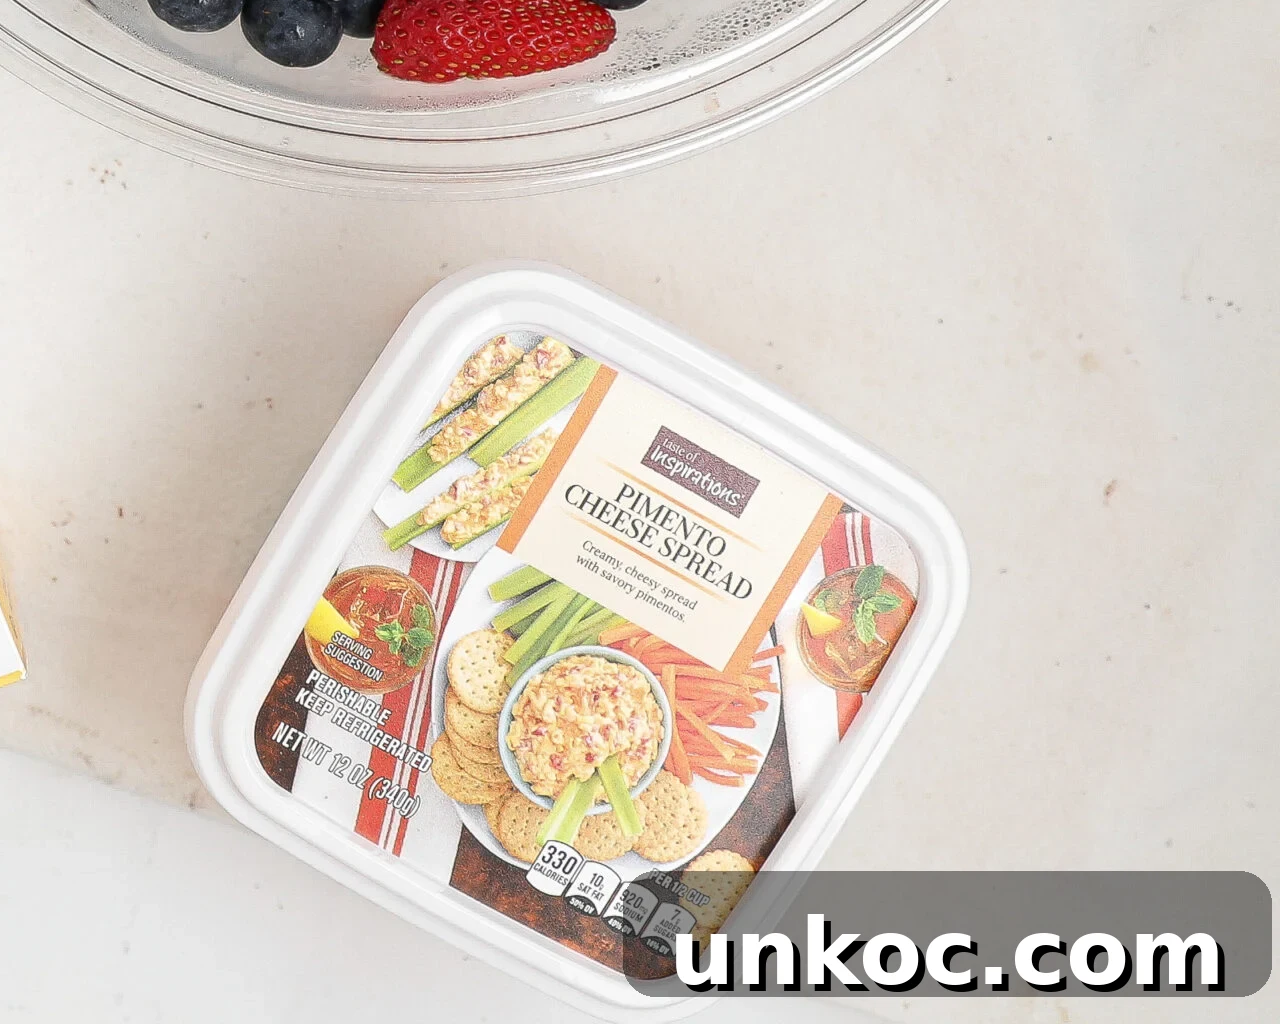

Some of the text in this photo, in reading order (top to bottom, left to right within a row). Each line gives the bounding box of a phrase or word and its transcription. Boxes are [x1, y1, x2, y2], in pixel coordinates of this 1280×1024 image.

[662, 438, 701, 463] taste of
[650, 445, 741, 506] Inspirations
[613, 482, 727, 558] PIMENTO
[564, 484, 753, 600] CHEESE SPREAD
[576, 554, 686, 623] with savory pimentos.
[582, 540, 699, 611] Creamy, cheesy spread
[324, 643, 383, 682] SUGGESTION
[332, 631, 373, 660] SERVING
[306, 669, 392, 726] PERISHABLE
[295, 687, 433, 773] KEEP REFRIGERATED
[272, 722, 421, 819] NET WT 12 OZ (340g)
[533, 862, 569, 887] CALORIES
[542, 845, 578, 875] 330
[569, 897, 584, 910] 50%
[577, 883, 605, 902] SAT FAT
[649, 868, 711, 908] PER 1/2 CUP
[613, 902, 643, 923] SODIUM
[659, 919, 681, 934] ADDED
